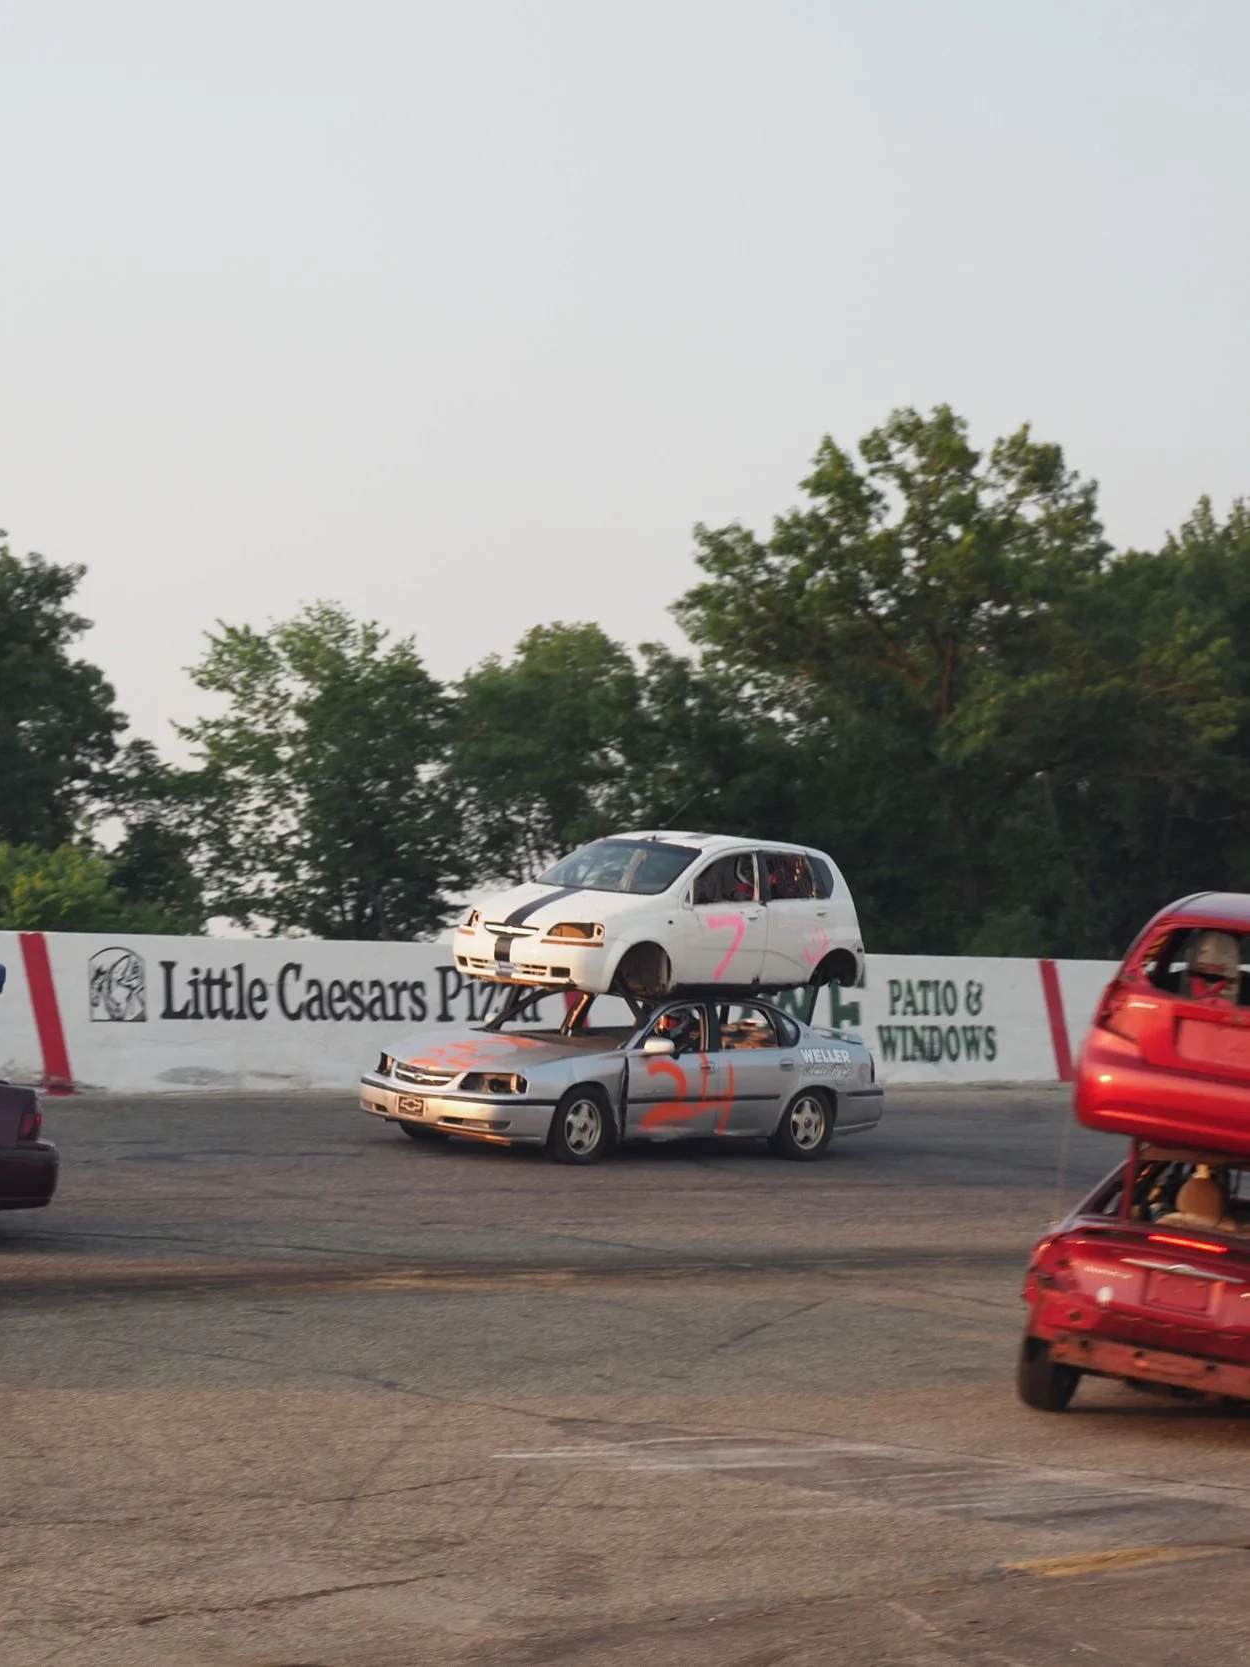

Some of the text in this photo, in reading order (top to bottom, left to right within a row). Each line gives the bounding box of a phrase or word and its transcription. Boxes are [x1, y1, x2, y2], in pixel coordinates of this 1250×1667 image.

[705, 913, 746, 982] 7
[159, 961, 267, 1021] Little
[276, 962, 427, 1023] Caesars
[888, 979, 958, 1016] PATIO
[965, 979, 984, 1016] &
[799, 1048, 851, 1063] WELLER
[876, 1025, 997, 1062] WINDOWS
[637, 1052, 735, 1137] 24
